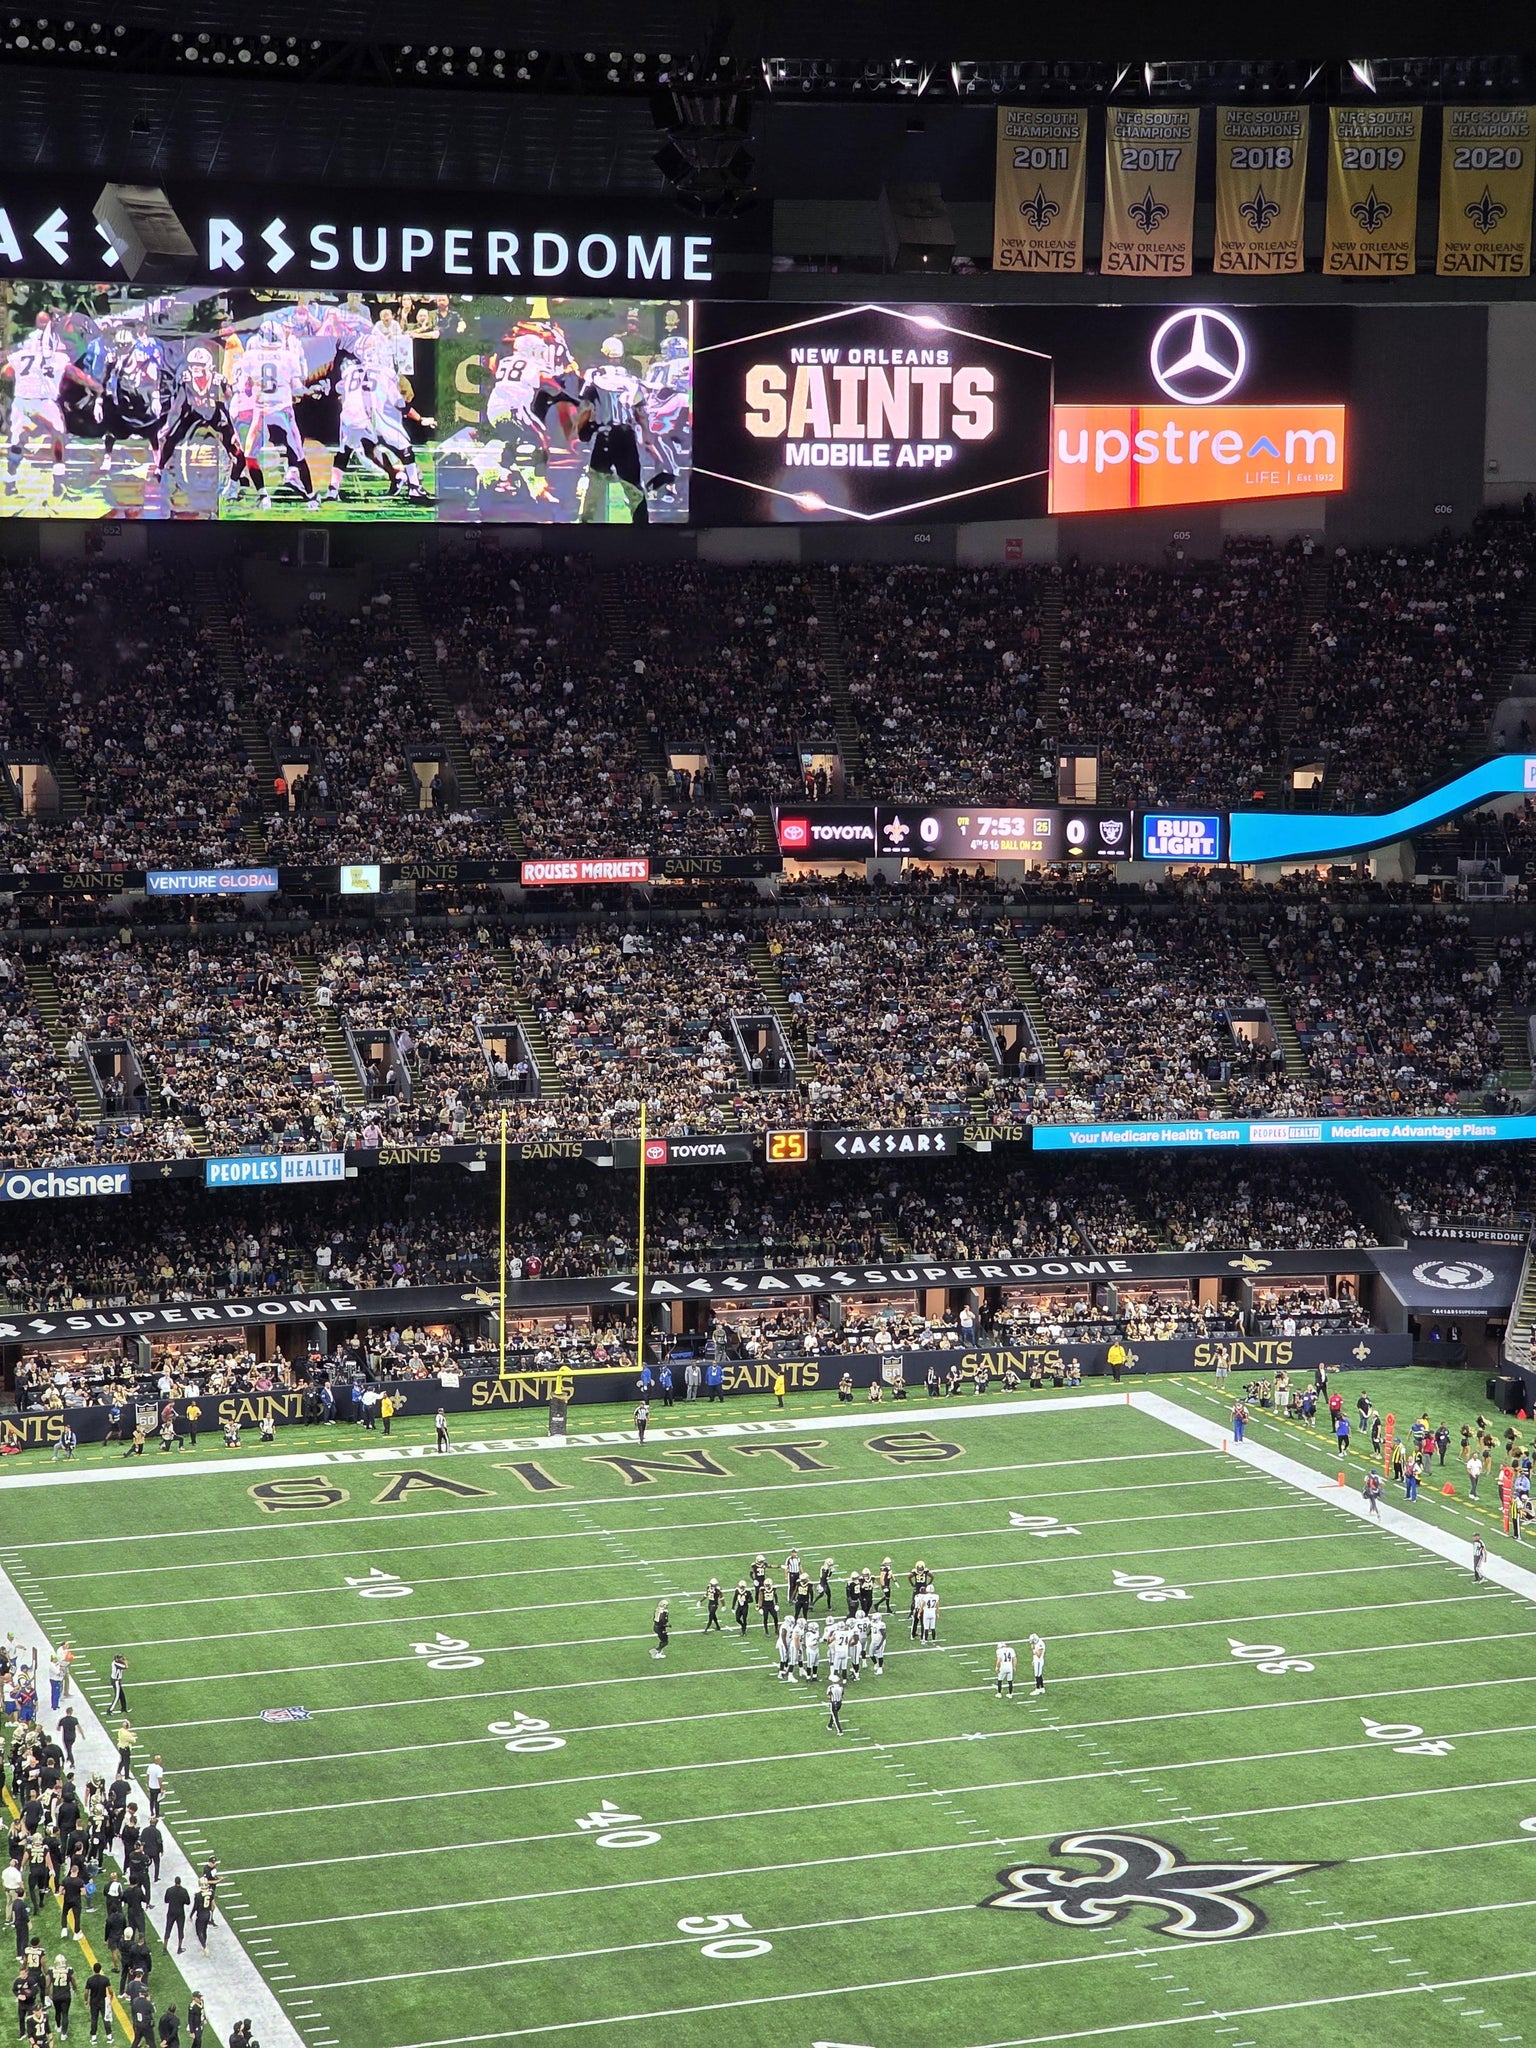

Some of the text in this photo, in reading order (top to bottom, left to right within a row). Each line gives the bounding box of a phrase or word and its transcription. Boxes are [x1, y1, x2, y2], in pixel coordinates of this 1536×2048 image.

[1007, 112, 1078, 125] NFC SOUTH
[1116, 112, 1188, 125] NFC SOUTH
[1227, 111, 1299, 124] NFC SOUTH
[1340, 111, 1412, 124] NFC SOUTH
[1453, 111, 1527, 124] NFC SOUTH
[1004, 125, 1079, 139] CHAMPIONS
[1114, 125, 1190, 139] CHAMPIONS
[1223, 124, 1301, 138] CHAMPIONS
[1336, 124, 1414, 138] CHAMPIONS
[1450, 124, 1530, 138] CHAMPIONS
[1013, 147, 1068, 169] 2011
[1121, 148, 1181, 171] 2017
[1231, 147, 1293, 169] 2018
[1342, 147, 1404, 170] 2019
[1454, 148, 1523, 170] 2020
[309, 224, 712, 281] SUPERDOME
[1001, 238, 1076, 250] NEW ORLEANS
[1109, 241, 1186, 252] NEW ORLEANS
[1221, 240, 1298, 251] NEW ORLEANS
[1332, 241, 1409, 252] NEW ORLEANS
[1445, 242, 1524, 253] NEW ORLEANS
[1000, 249, 1076, 269] SAINTS
[1108, 251, 1186, 272] SAINTS
[1220, 251, 1298, 270] SAINTS
[1330, 251, 1409, 271] SAINTS
[1443, 252, 1524, 272] SAINTS
[790, 349, 949, 365] NEW ORLEANS
[745, 364, 994, 440] SAINTS
[785, 443, 953, 467] MOBILE APP
[1245, 472, 1334, 484] LIFE Est 1912
[1434, 504, 1453, 513] 606
[914, 534, 931, 543] 604
[1173, 531, 1190, 540] 605
[920, 817, 939, 842] 0
[957, 817, 969, 826] QTR
[977, 817, 1025, 836] 7:53
[1037, 821, 1048, 833] 25
[1157, 820, 1206, 837] BUD
[811, 825, 874, 840] TOYOTA
[960, 826, 966, 836] 1
[1066, 820, 1085, 844] 0
[1001, 840, 1018, 850] BALL
[1020, 840, 1030, 850] ON
[1031, 840, 1043, 850] 23
[1148, 837, 1212, 855] LIGHT
[400, 864, 458, 880] SAINTS
[524, 861, 646, 880] ROUSES MARKETS
[665, 859, 722, 874] SAINTS
[63, 873, 124, 889] SAINTS
[149, 872, 276, 890] VENTURE GLOBAL
[963, 1126, 1023, 1142] SAINTS
[1069, 1131, 1099, 1144] Your
[1101, 1130, 1159, 1143] Medicare
[1161, 1129, 1203, 1141] Health
[1205, 1128, 1240, 1140] Team
[1253, 1129, 1287, 1138] PEOPLES
[1331, 1125, 1390, 1138] Medicare
[1391, 1124, 1461, 1139] Advantage
[1462, 1124, 1497, 1136] Plans
[521, 1143, 583, 1159] SAINTS
[670, 1143, 726, 1158] TOYOTA
[772, 1135, 802, 1158] 25
[834, 1133, 946, 1155] CAESARS
[378, 1148, 441, 1166] SAINTS
[210, 1158, 342, 1183] PEOPLES HEALTH
[6, 1172, 126, 1200] Ochsner
[1466, 1230, 1524, 1241] SUPERDOME
[610, 1260, 1133, 1296] CAESARS SUPERDOME
[66, 1297, 357, 1331] SUPERDOME
[1194, 1341, 1293, 1367] SAINTS
[960, 1350, 1060, 1378] SAINTS
[721, 1362, 820, 1391] SAINTS
[471, 1375, 575, 1406] SAINTS
[140, 1416, 155, 1426] 60
[325, 1421, 797, 1462] IT TAKES ALL OF US
[247, 1432, 966, 1513] SAINTS
[1009, 1515, 1082, 1538] 10
[344, 1573, 414, 1598] 10
[1113, 1575, 1194, 1602] 20
[409, 1639, 485, 1670] 20
[1004, 1652, 1011, 1662] 14
[1231, 1643, 1316, 1675] 30
[487, 1718, 567, 1753] 30
[1365, 1723, 1457, 1757] 40
[574, 1811, 662, 1848] 40
[31, 1852, 44, 1864] 76
[203, 1895, 211, 1908] 6
[676, 1913, 773, 1959] 50
[53, 1973, 68, 1987] 72
